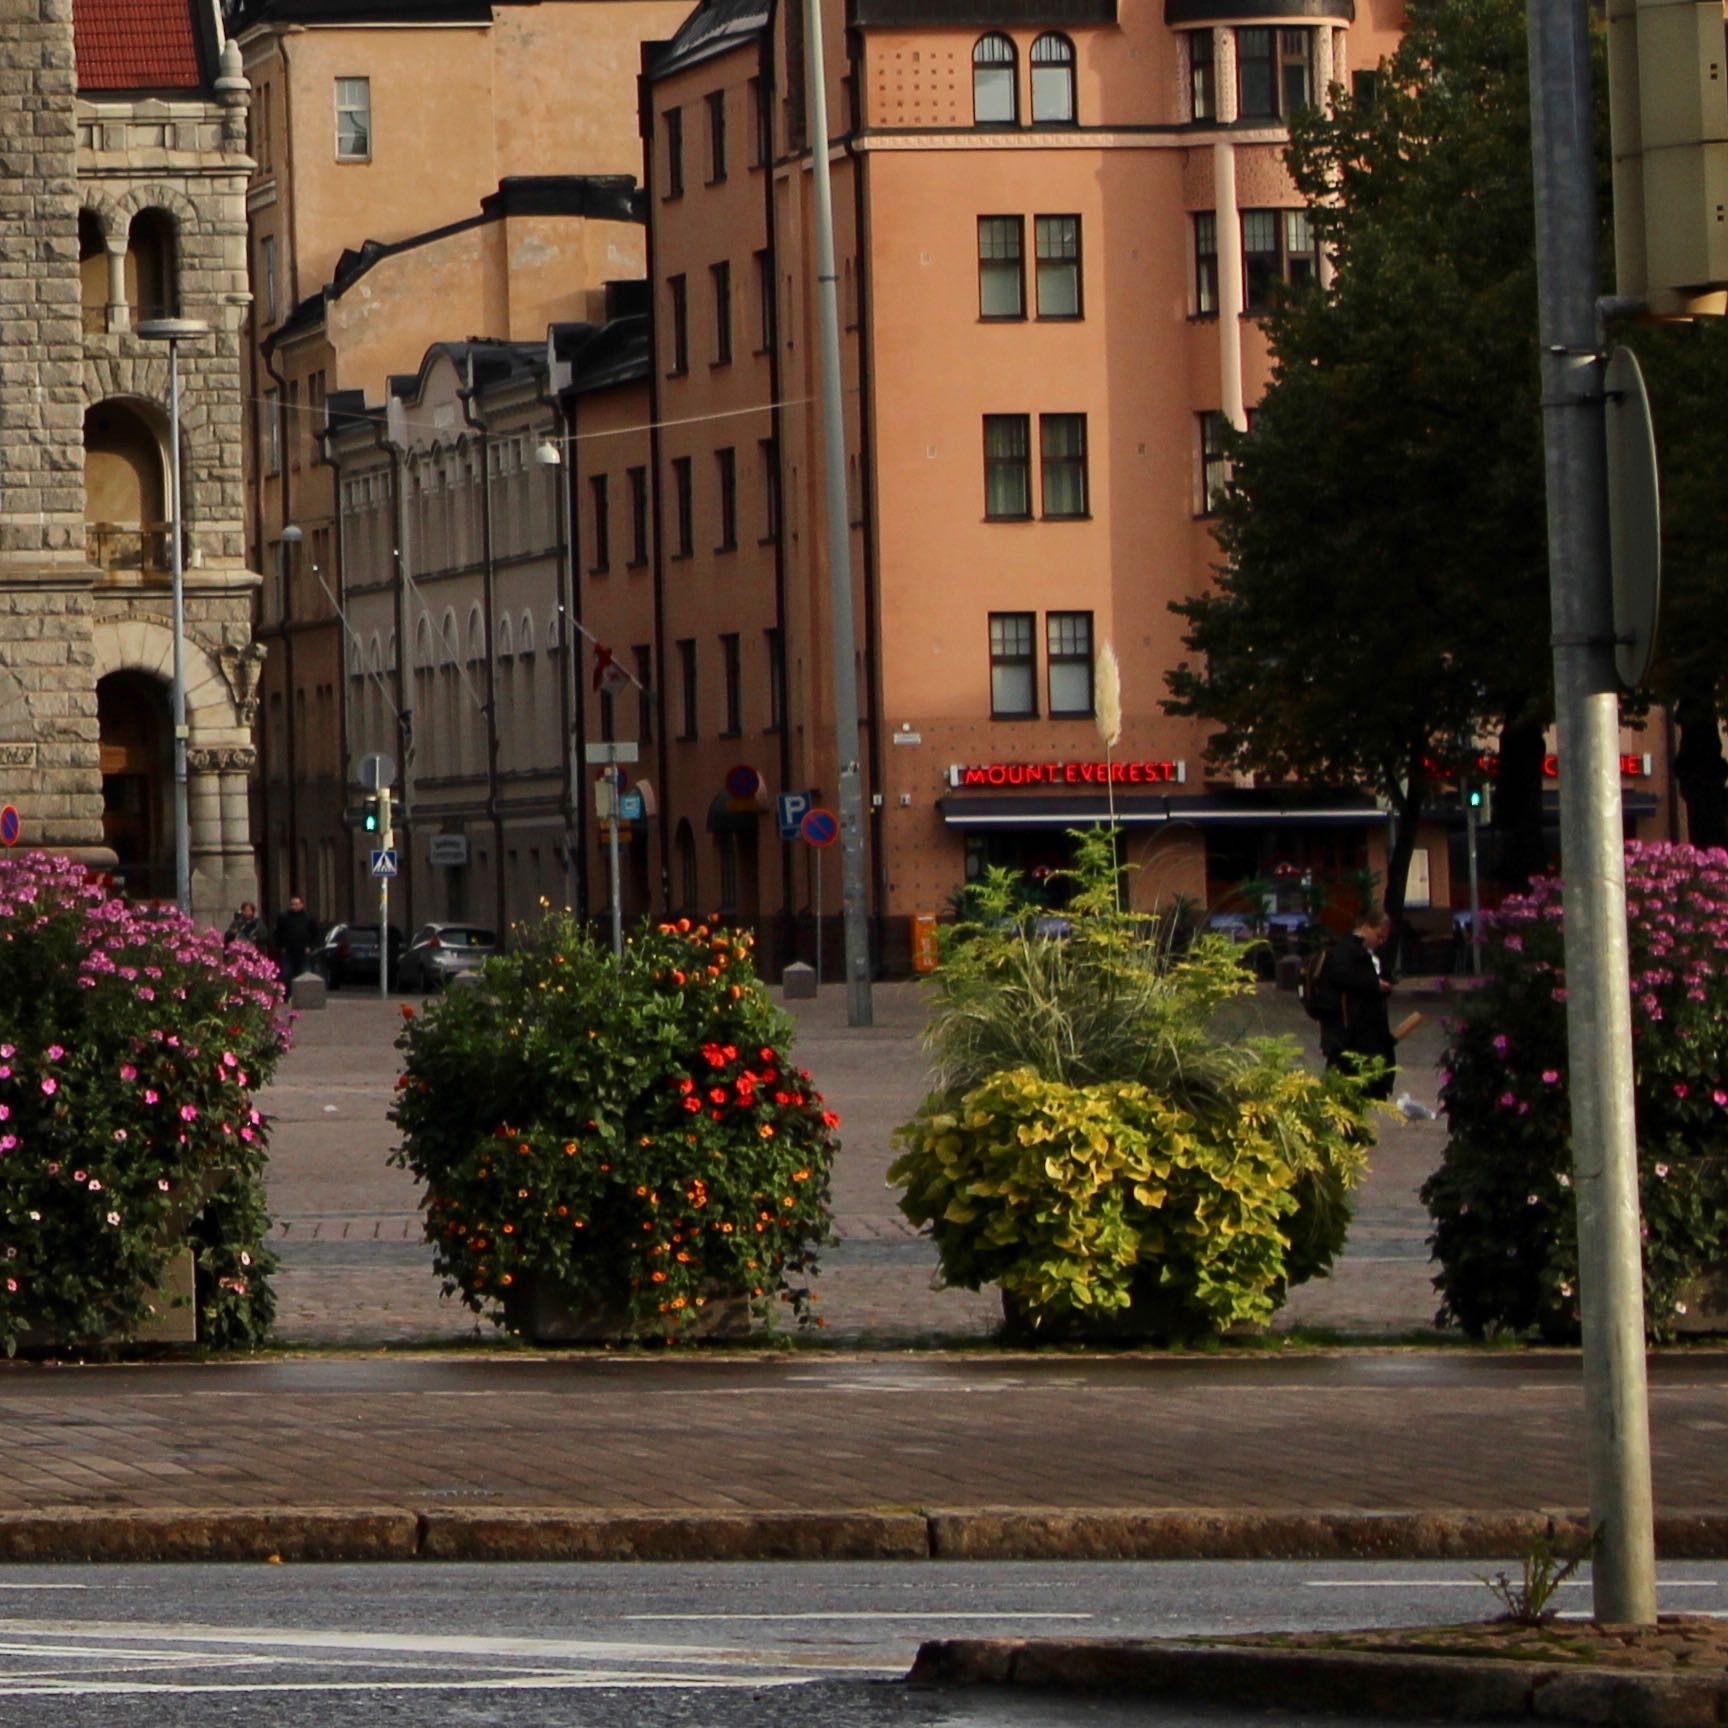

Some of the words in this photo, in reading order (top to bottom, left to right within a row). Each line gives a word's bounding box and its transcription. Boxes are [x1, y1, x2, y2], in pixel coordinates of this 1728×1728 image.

[965, 764, 1059, 784] MOUNT
[1065, 762, 1173, 783] EVEREST
[784, 795, 806, 824] P
